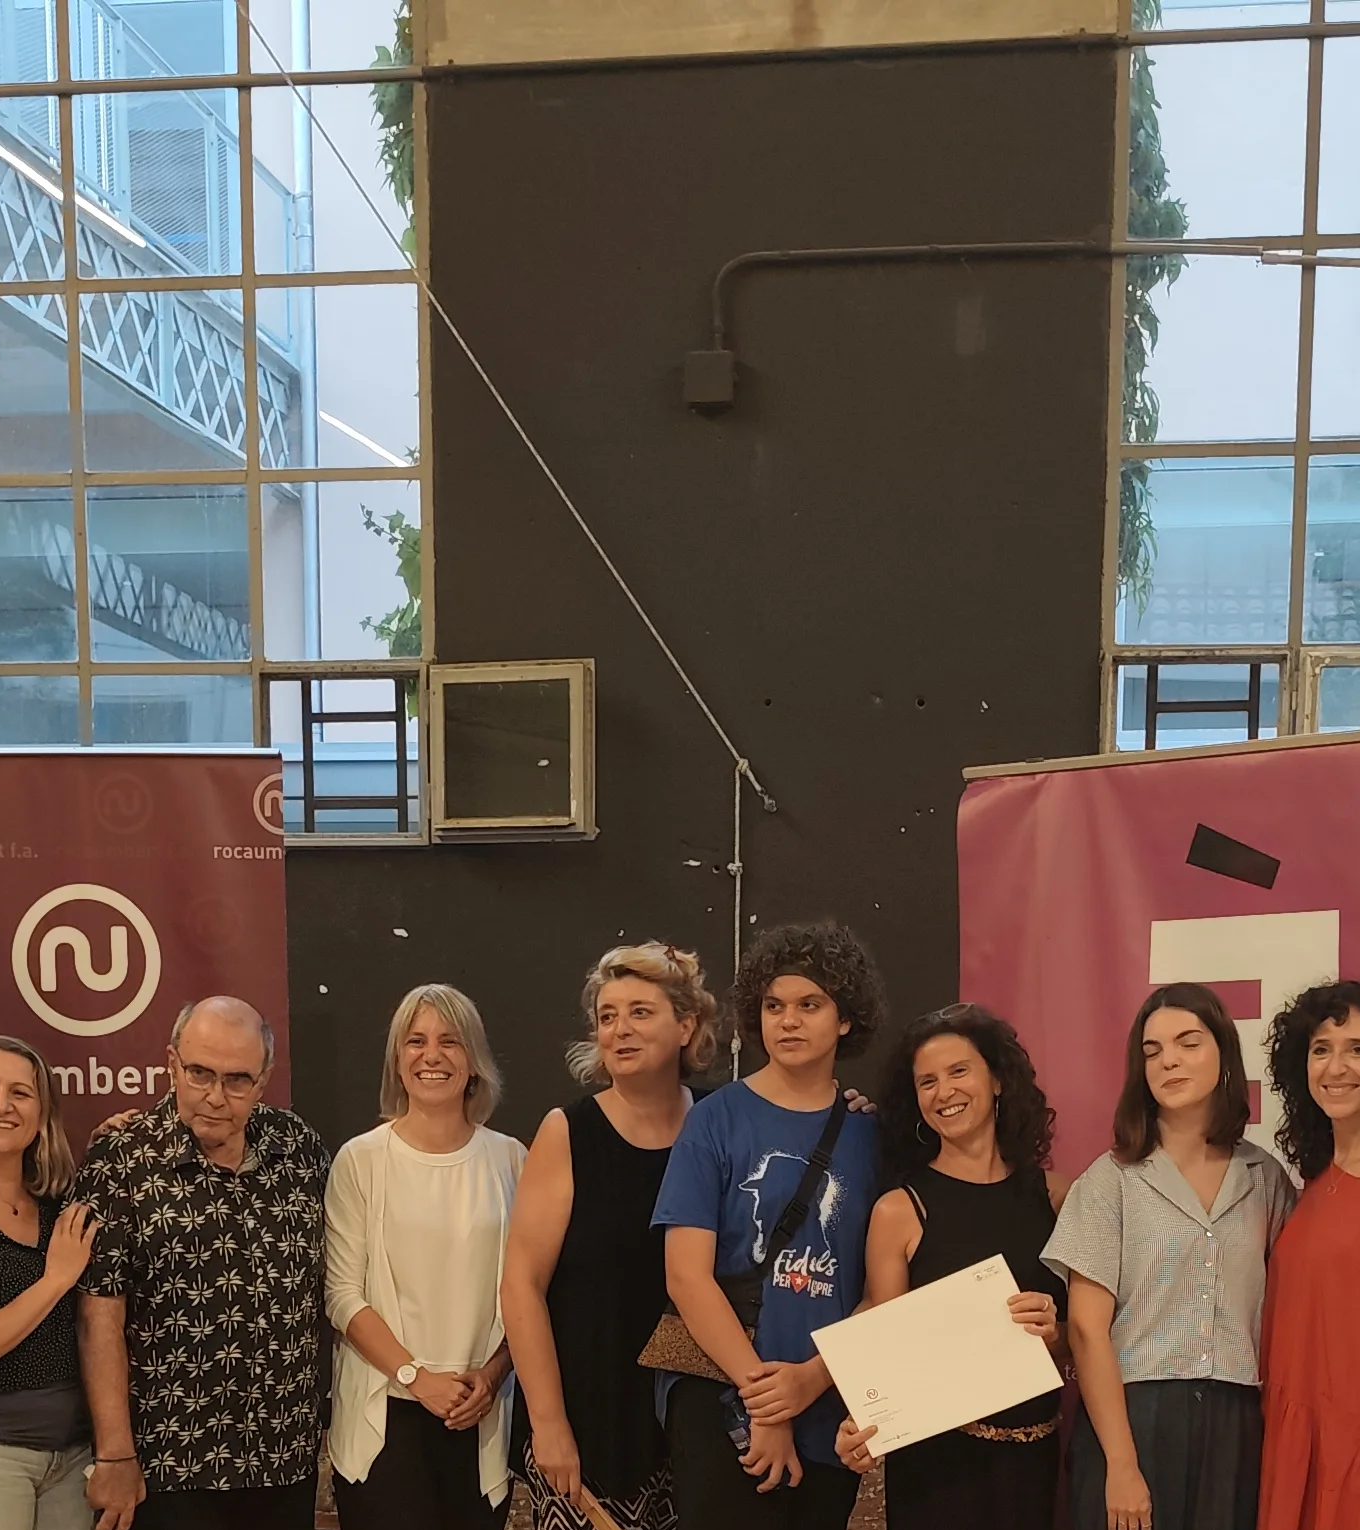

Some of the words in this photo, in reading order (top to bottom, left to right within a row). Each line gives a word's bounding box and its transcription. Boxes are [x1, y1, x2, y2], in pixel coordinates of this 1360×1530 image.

[10, 843, 39, 859] f.a.
[213, 846, 282, 860] rocaum
[772, 1273, 791, 1289] PER
